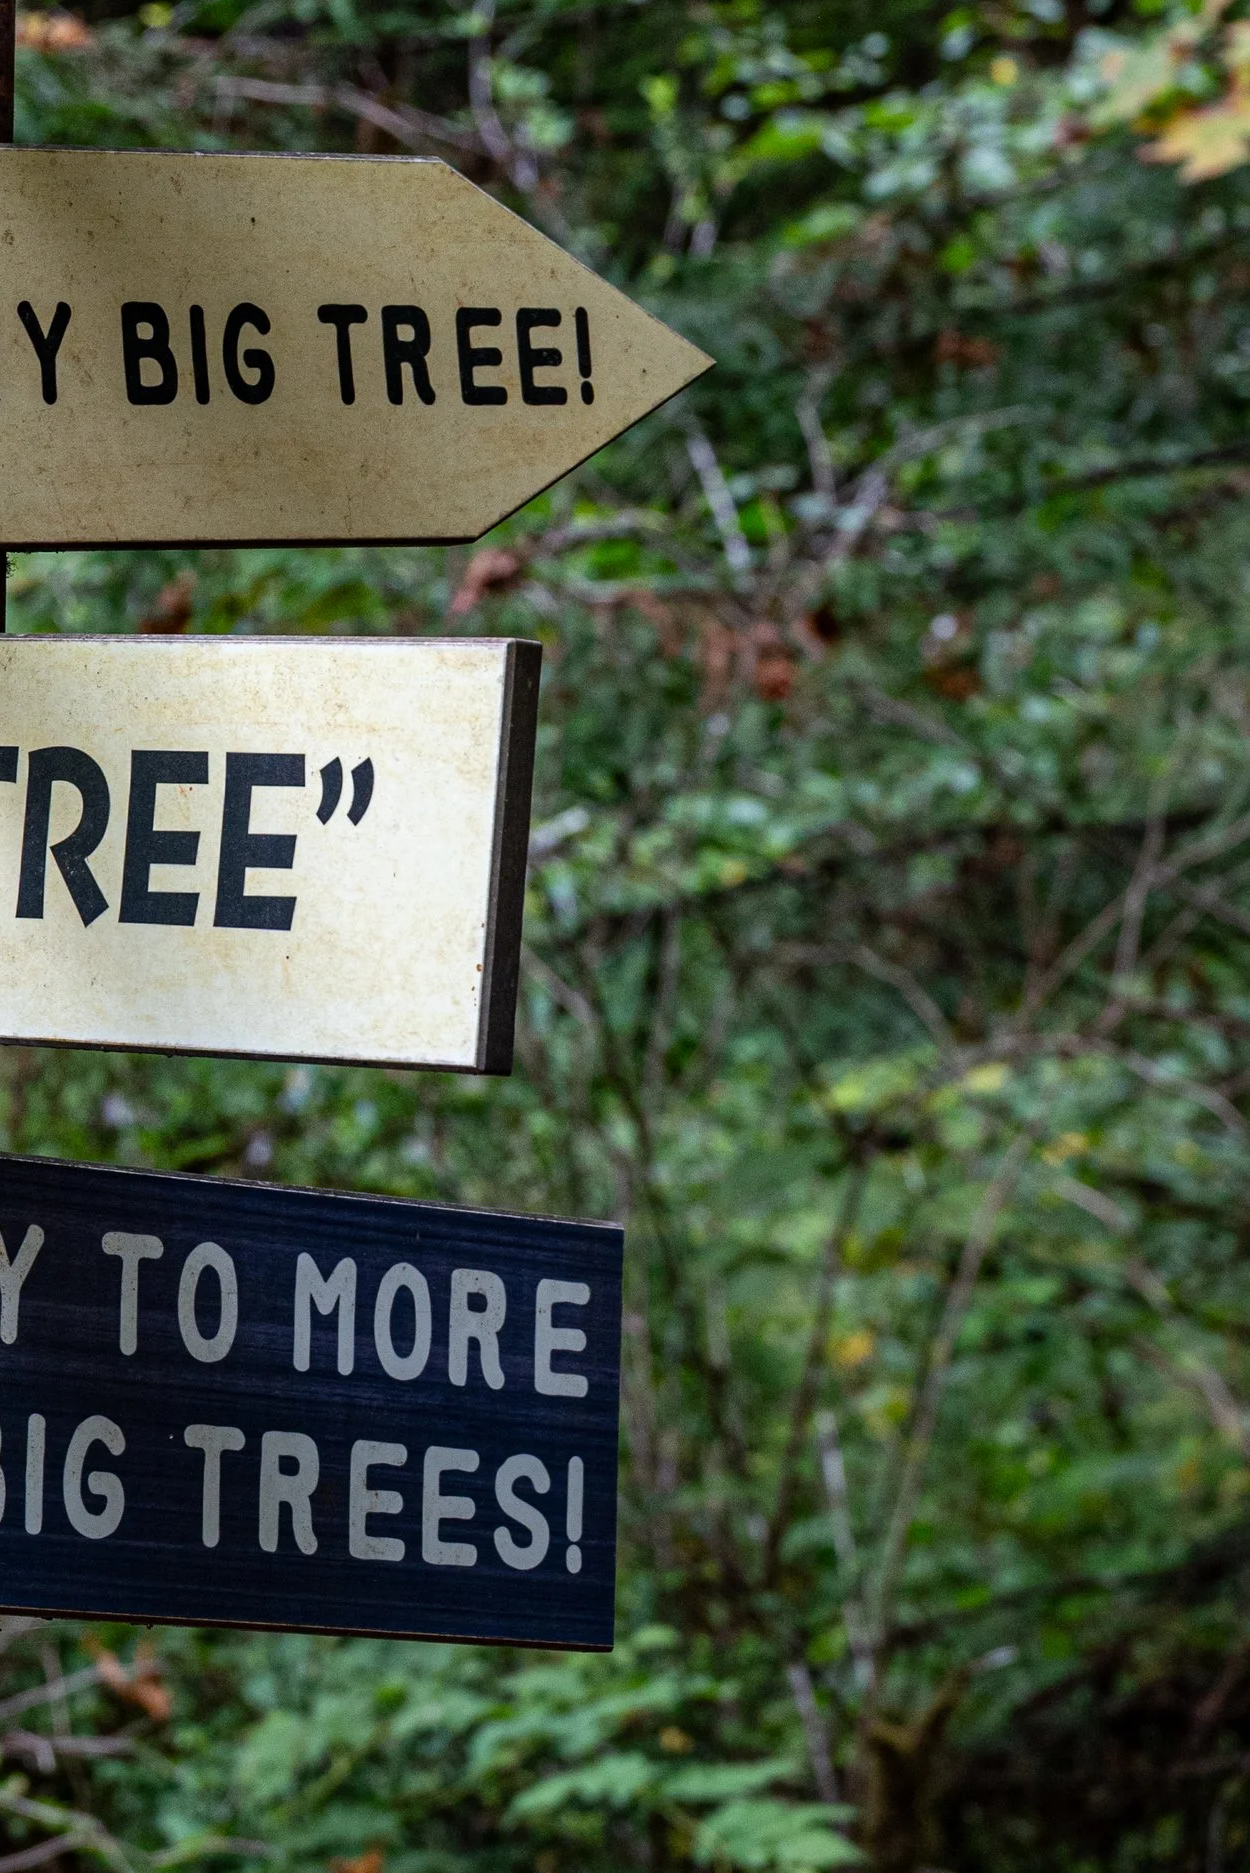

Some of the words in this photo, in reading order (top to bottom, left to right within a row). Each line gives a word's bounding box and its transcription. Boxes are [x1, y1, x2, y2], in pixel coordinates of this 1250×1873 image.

[121, 301, 275, 405] BIG
[317, 304, 594, 406] TREE!
[102, 1232, 238, 1362] TO
[293, 1252, 590, 1397] MORE
[184, 1424, 583, 1574] TREES!
